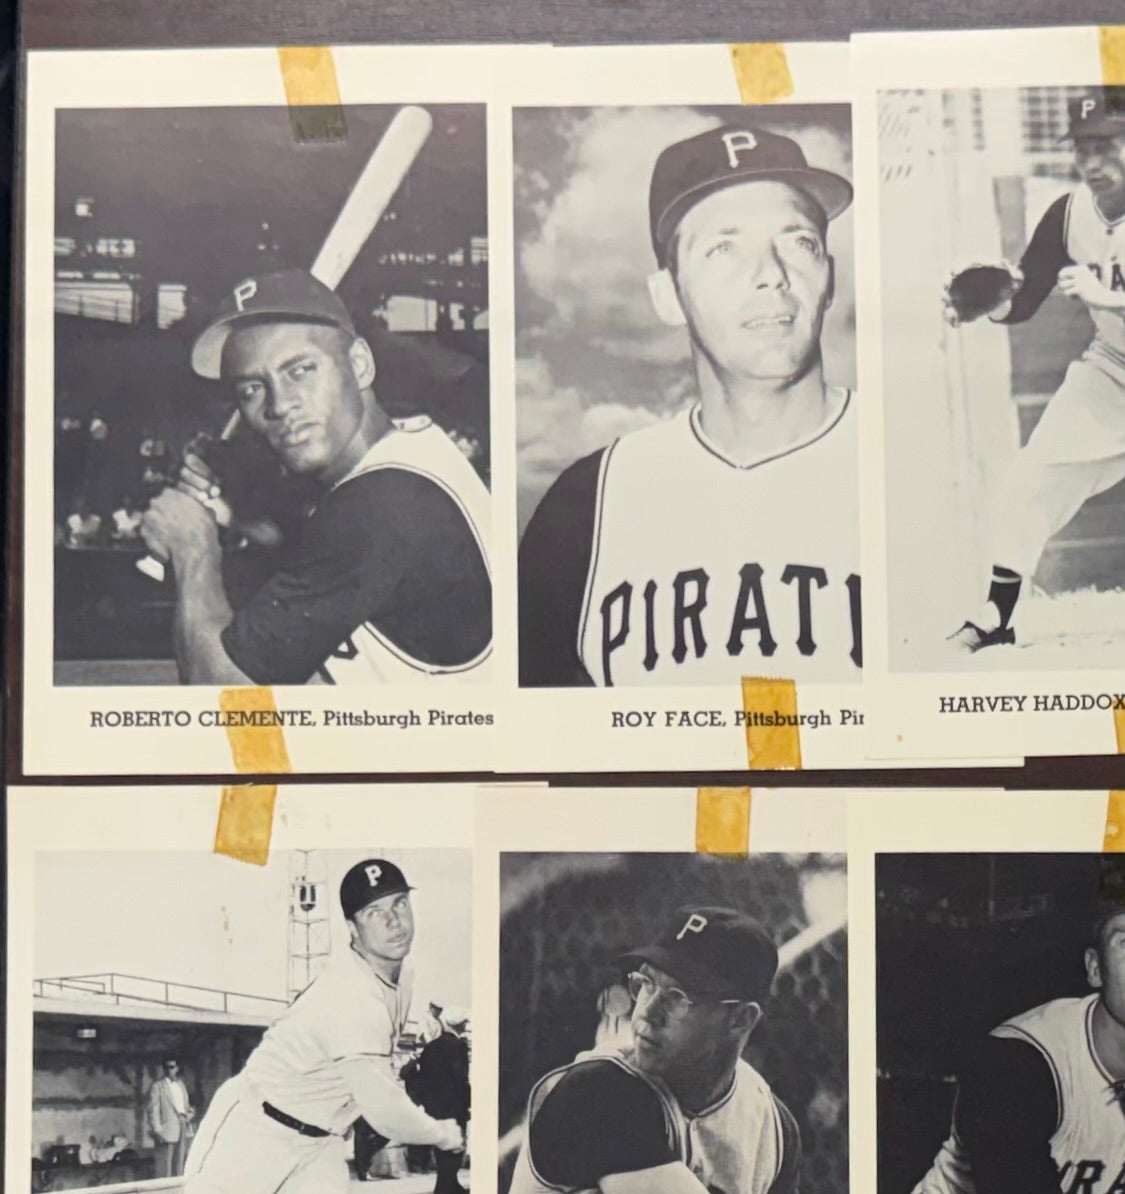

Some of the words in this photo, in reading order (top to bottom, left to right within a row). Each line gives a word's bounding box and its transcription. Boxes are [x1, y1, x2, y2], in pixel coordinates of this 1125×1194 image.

[1081, 99, 1096, 119] P
[722, 131, 757, 168] P
[234, 278, 257, 312] P
[939, 695, 1027, 713] HARVEY
[90, 711, 192, 728] ROBERTO
[198, 710, 317, 730] CLEMENTE,
[323, 709, 421, 729] Pittsburgh
[428, 709, 494, 726] Pirates
[611, 711, 657, 728] ROY
[664, 710, 727, 728] FACE,
[734, 710, 832, 729] Pittsburgh
[364, 864, 382, 887] P
[676, 913, 708, 940] P
